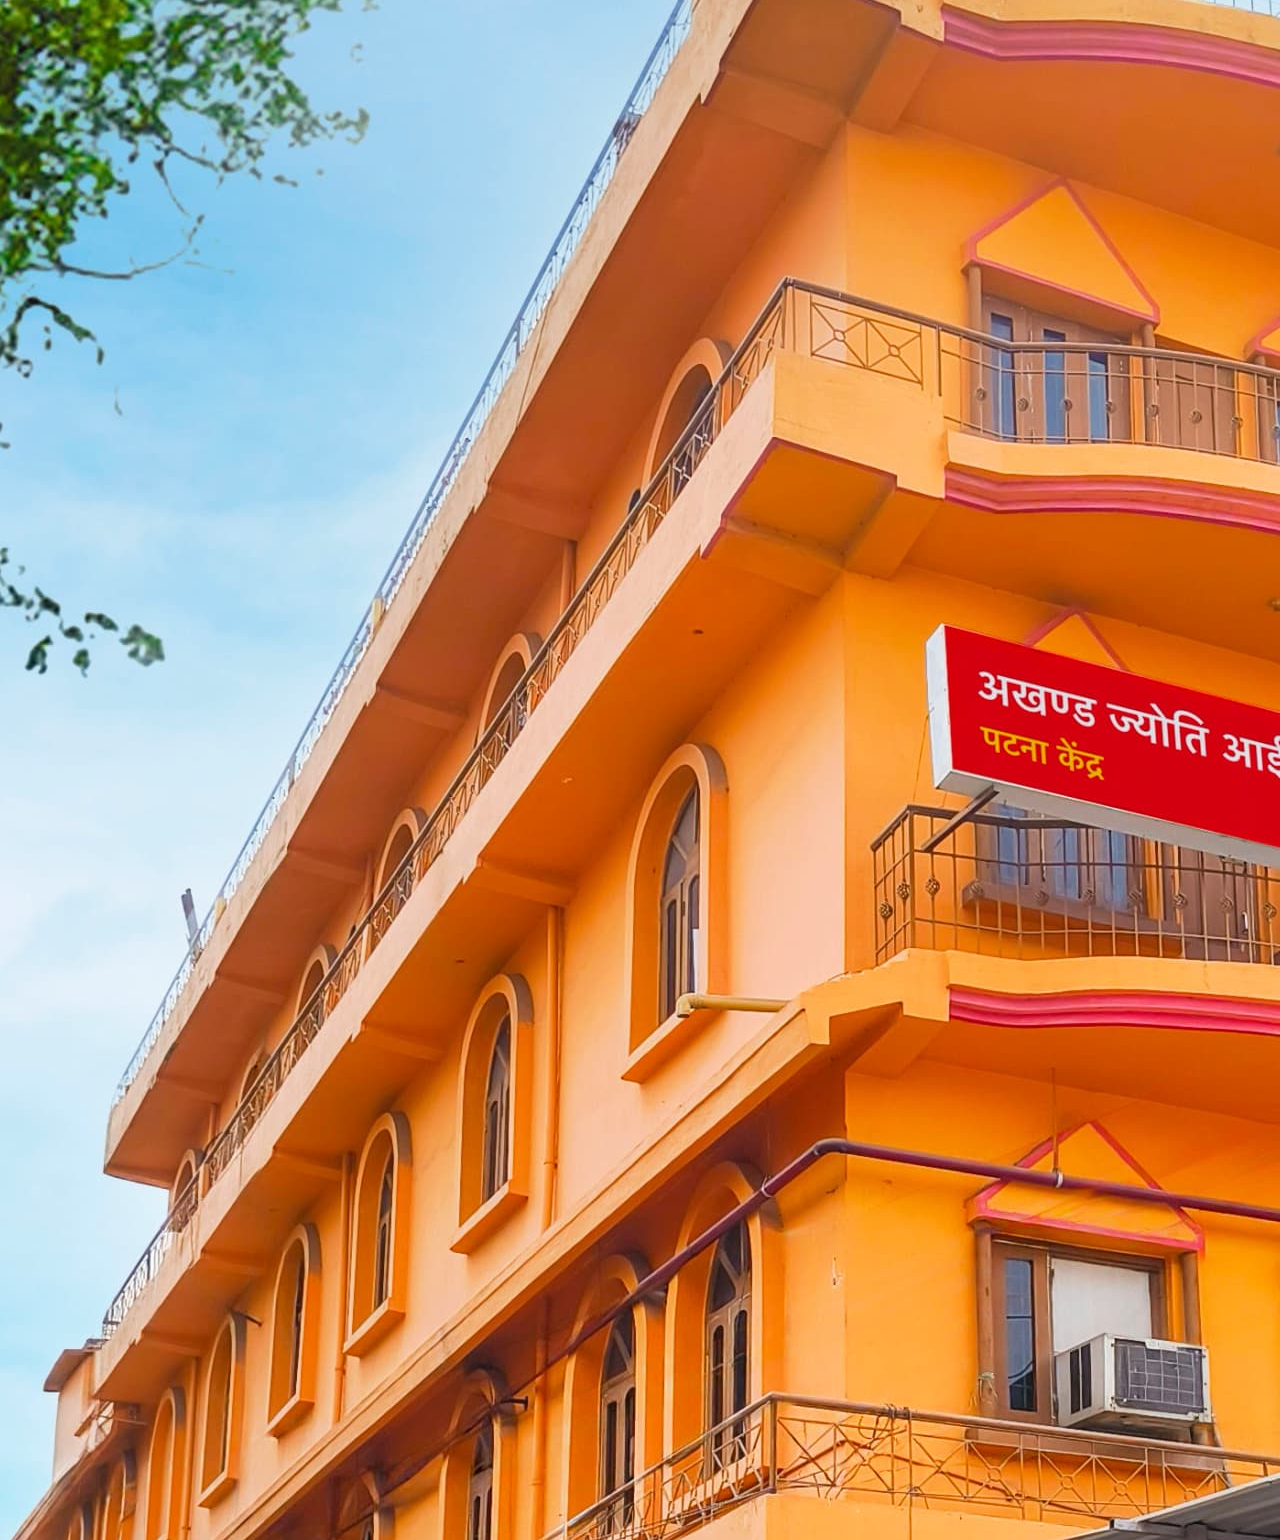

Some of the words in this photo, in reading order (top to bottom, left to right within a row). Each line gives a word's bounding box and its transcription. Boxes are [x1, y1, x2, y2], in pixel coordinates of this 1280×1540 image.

[978, 671, 1097, 727] अखण्ड
[1106, 703, 1210, 757] ज्योति
[979, 726, 1049, 765] पटना
[1056, 737, 1105, 781] केंद्र
